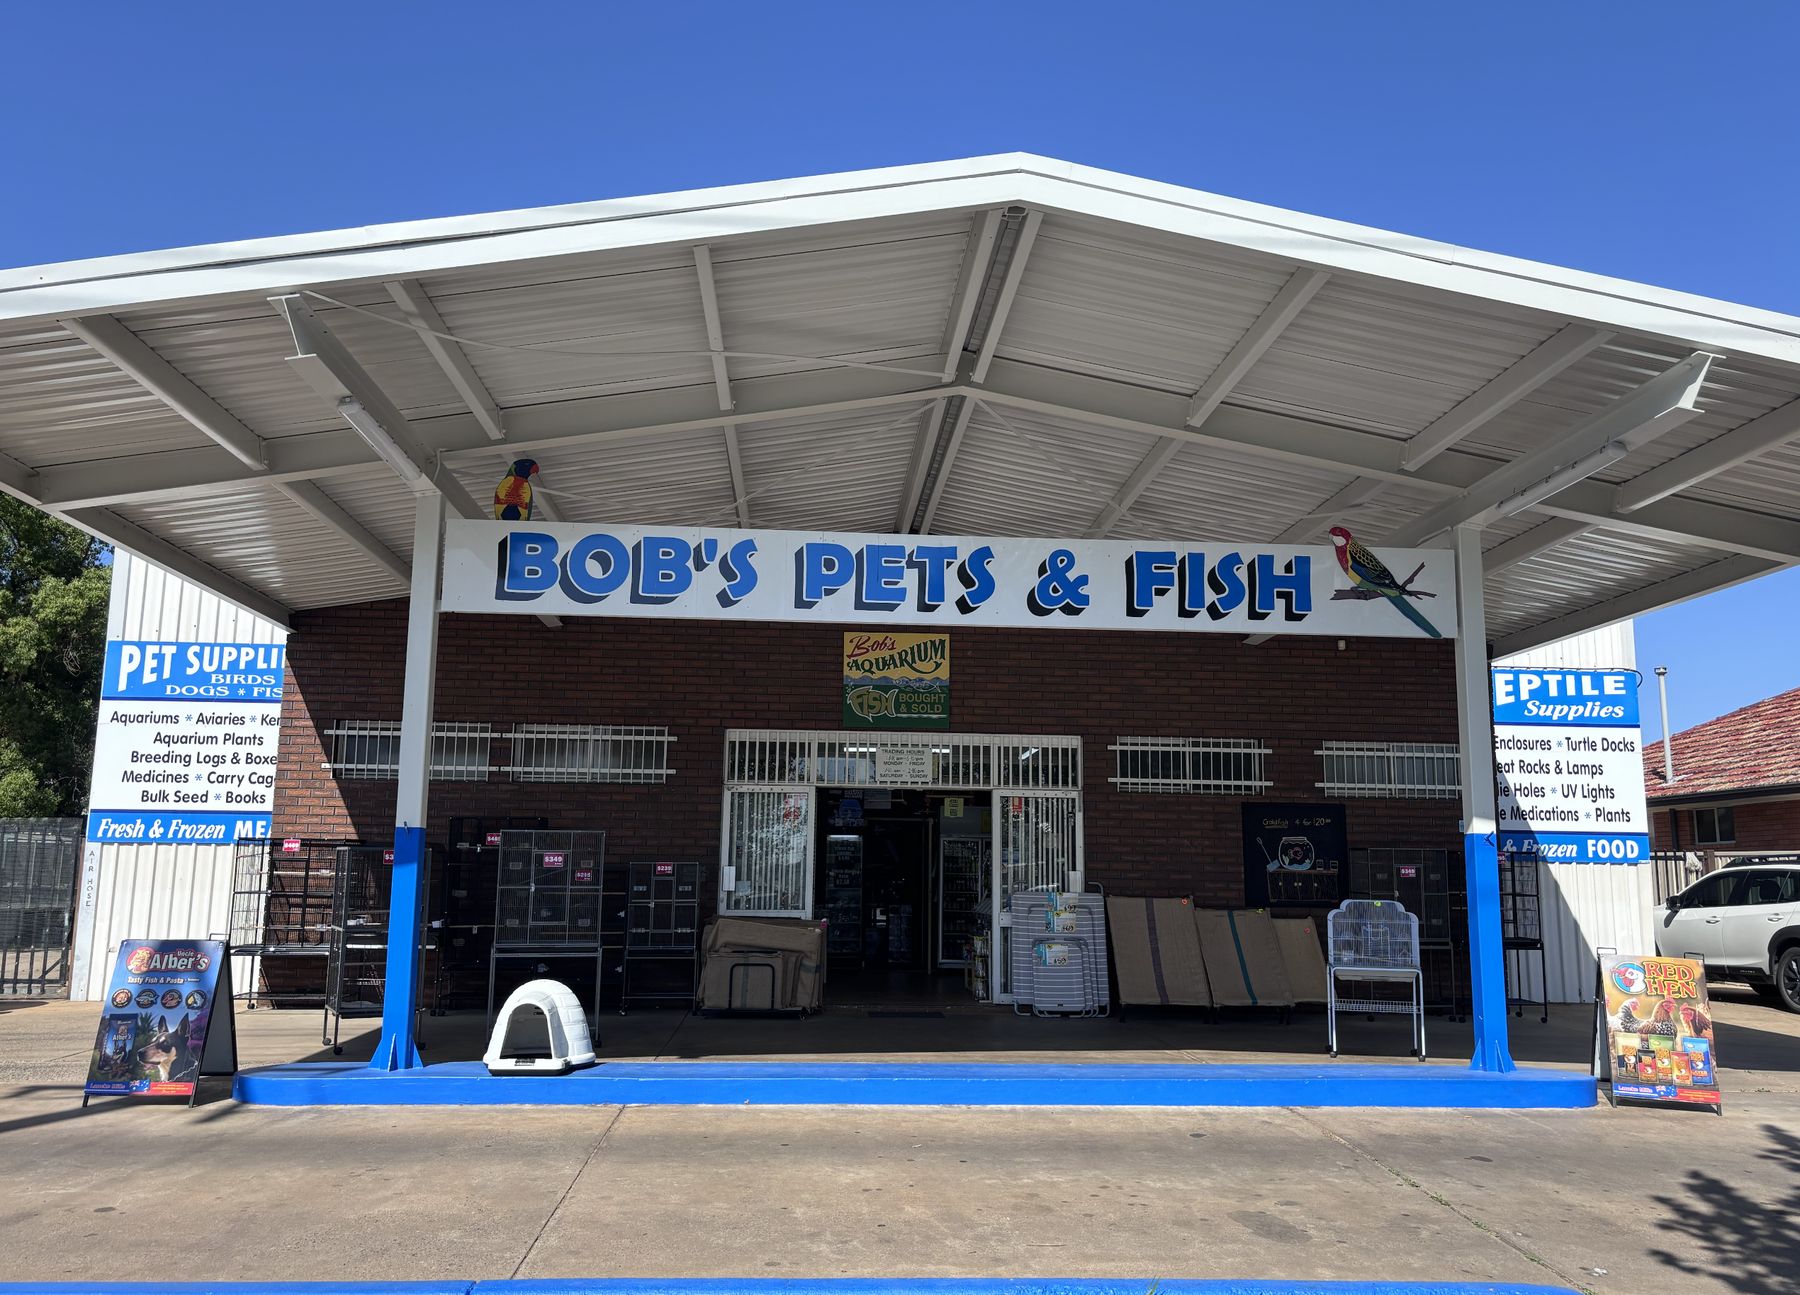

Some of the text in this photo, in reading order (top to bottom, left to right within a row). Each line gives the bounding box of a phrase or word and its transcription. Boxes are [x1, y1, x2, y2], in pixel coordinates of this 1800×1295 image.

[495, 532, 1312, 622] BOB'S PETS & FISH
[846, 634, 897, 659] Bob's
[846, 638, 947, 675] AQUARIUM
[117, 644, 177, 693] PET
[210, 673, 276, 685] BIRDS
[165, 684, 230, 697] DOGS
[899, 693, 946, 703] BOUGHT
[1494, 673, 1627, 706] EPTILE
[852, 688, 898, 717] FISH
[900, 703, 943, 713] & SOLD
[1524, 700, 1625, 721] Supplies
[110, 711, 180, 727] Aquariums
[195, 712, 246, 726] Aviaries
[153, 731, 264, 747] Aquarium Plants
[1494, 734, 1636, 753] Enclosures Turtle Docks
[131, 750, 277, 767] Breeding Logs & Boxe
[1518, 759, 1551, 775] Rocks
[1554, 760, 1563, 775] &
[1566, 760, 1604, 779] Lamps
[121, 770, 276, 788] Medicines Carry Cag
[141, 789, 266, 804] Bulk Seed Books
[1514, 782, 1546, 798] Holes
[1561, 783, 1578, 799] UV
[1581, 783, 1615, 803] Lights
[1262, 818, 1289, 826] Goldfish
[1510, 805, 1580, 822] Medications
[1595, 807, 1631, 822] Plants
[97, 818, 145, 839] Fresh
[148, 819, 164, 838] &
[168, 819, 226, 840] Frozen
[1521, 839, 1578, 858] Frozen
[1587, 839, 1639, 859] FOOD
[150, 953, 209, 970] Alber's
[127, 976, 144, 985] Tasty
[144, 976, 159, 984] Fish
[1643, 961, 1695, 982] RED
[1645, 978, 1698, 999] HEN
